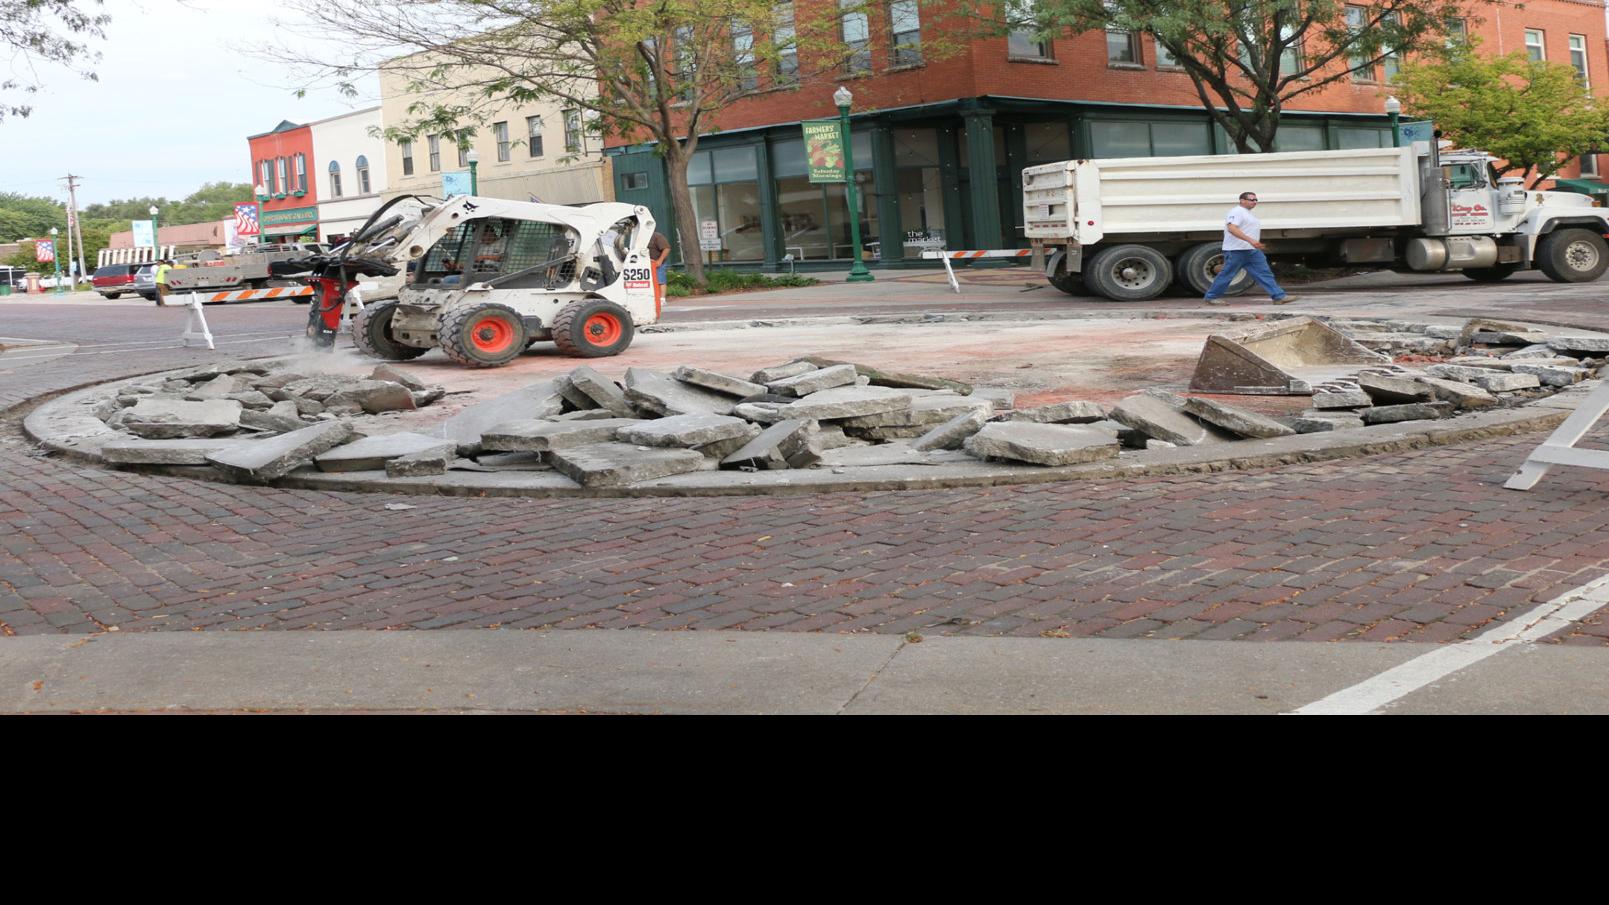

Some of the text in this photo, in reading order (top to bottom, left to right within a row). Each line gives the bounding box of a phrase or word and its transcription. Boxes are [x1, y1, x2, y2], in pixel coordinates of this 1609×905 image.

[815, 132, 839, 140] MARKET
[907, 230, 923, 238] the
[623, 268, 650, 280] S250
